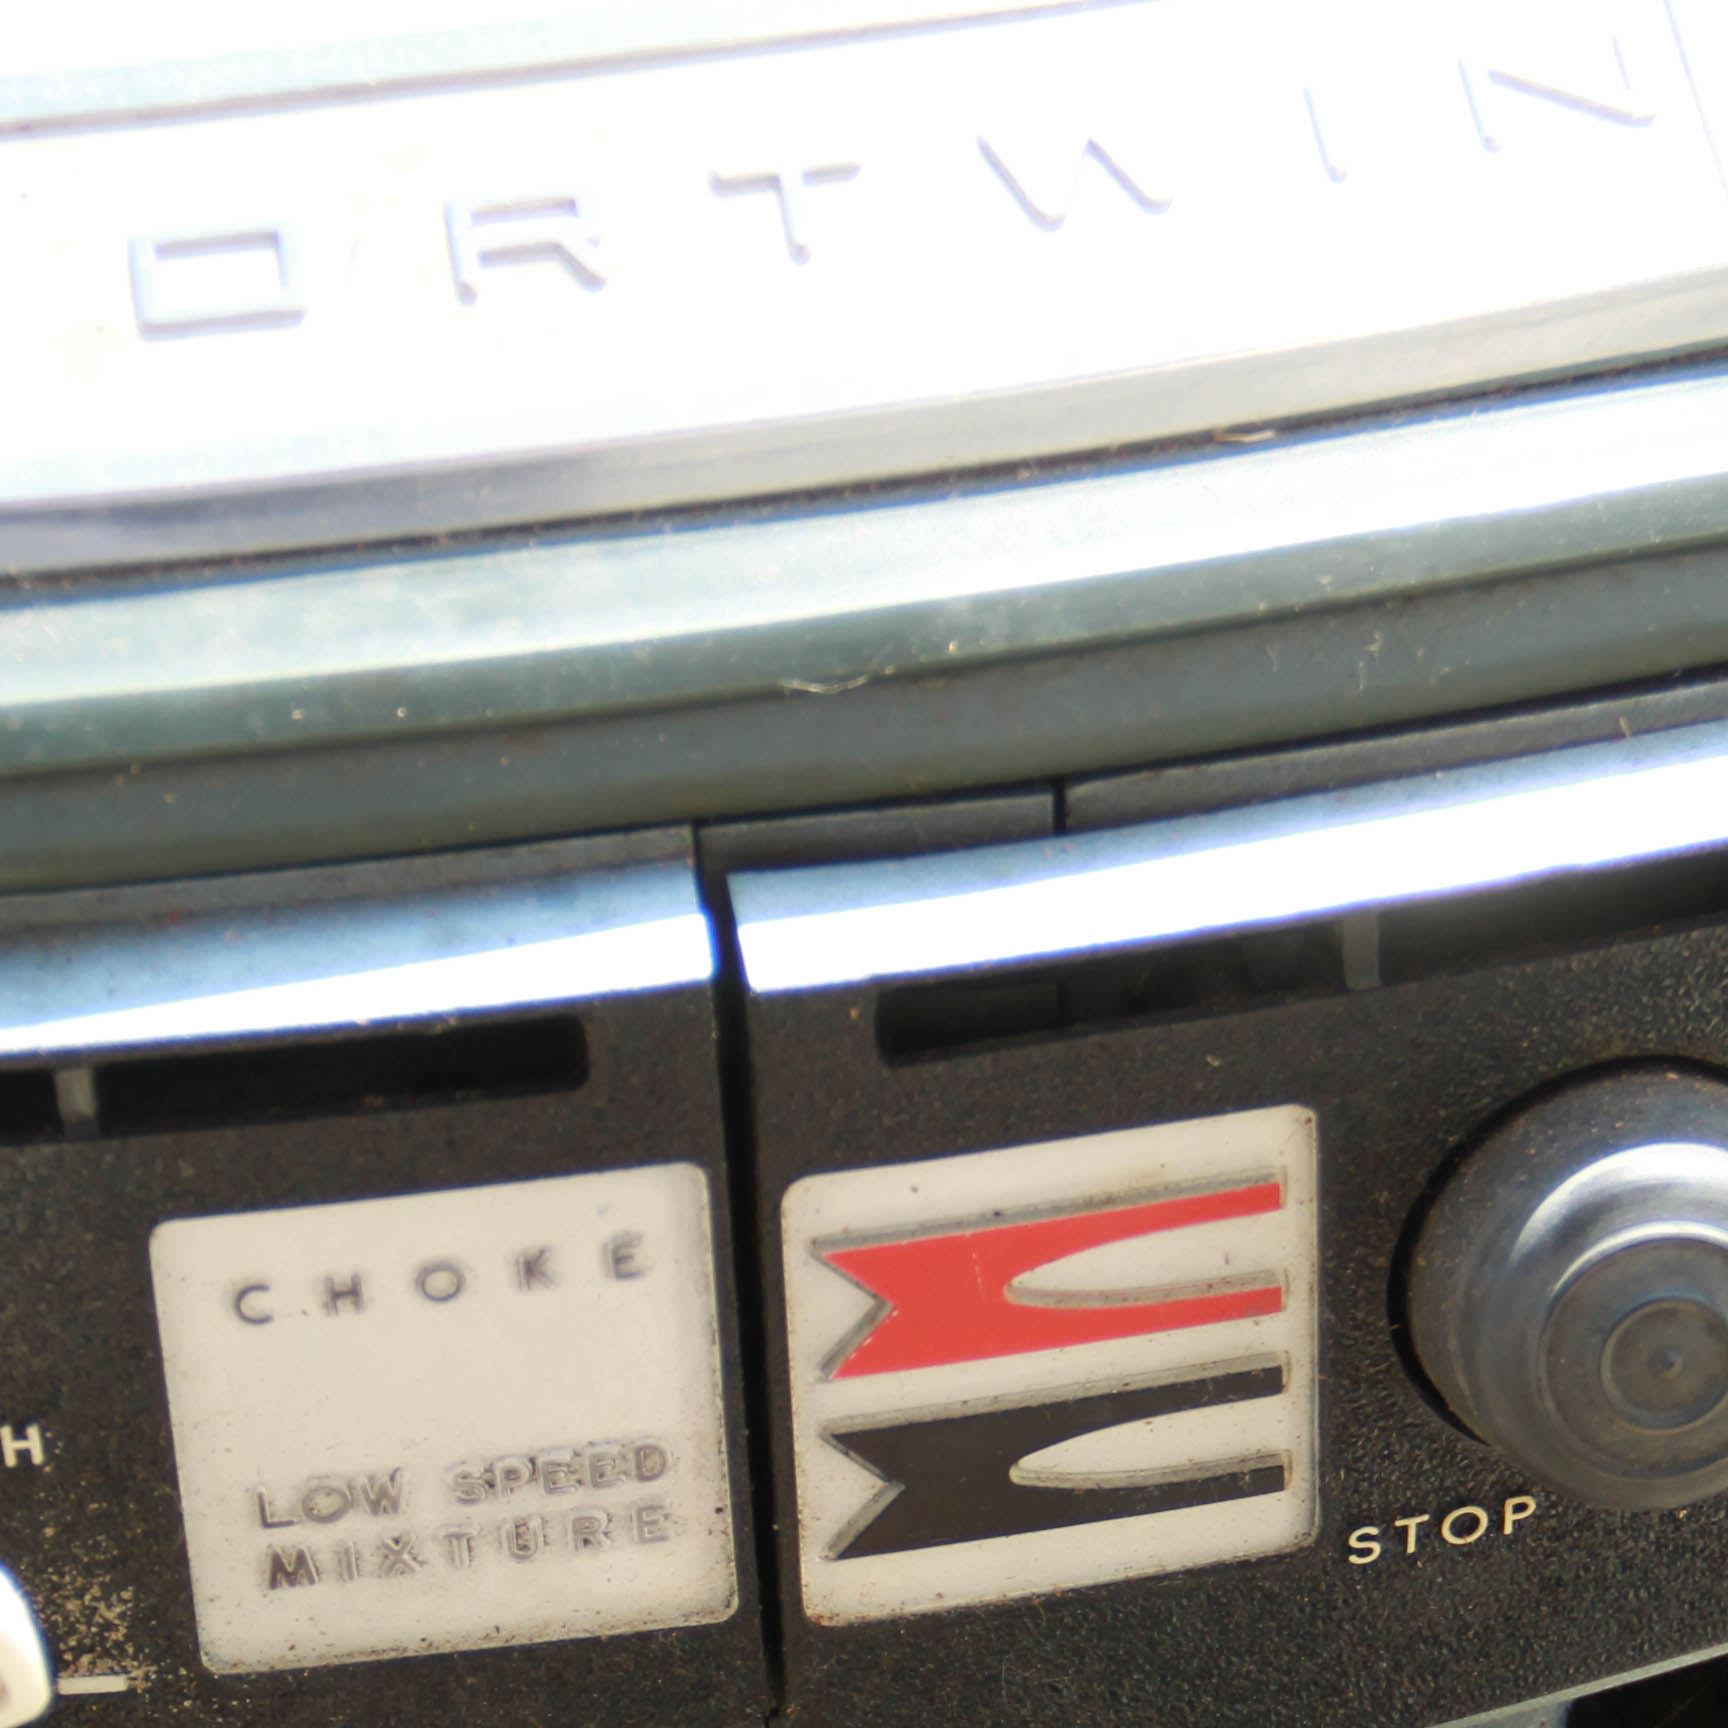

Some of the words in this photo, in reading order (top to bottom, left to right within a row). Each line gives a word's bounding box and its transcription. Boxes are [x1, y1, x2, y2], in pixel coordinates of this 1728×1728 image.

[232, 1231, 652, 1326] CHOKE
[255, 1466, 405, 1530] LOW
[448, 1438, 672, 1507] SPEED
[266, 1504, 672, 1591] MIXTURE
[1346, 1494, 1538, 1566] STOP
